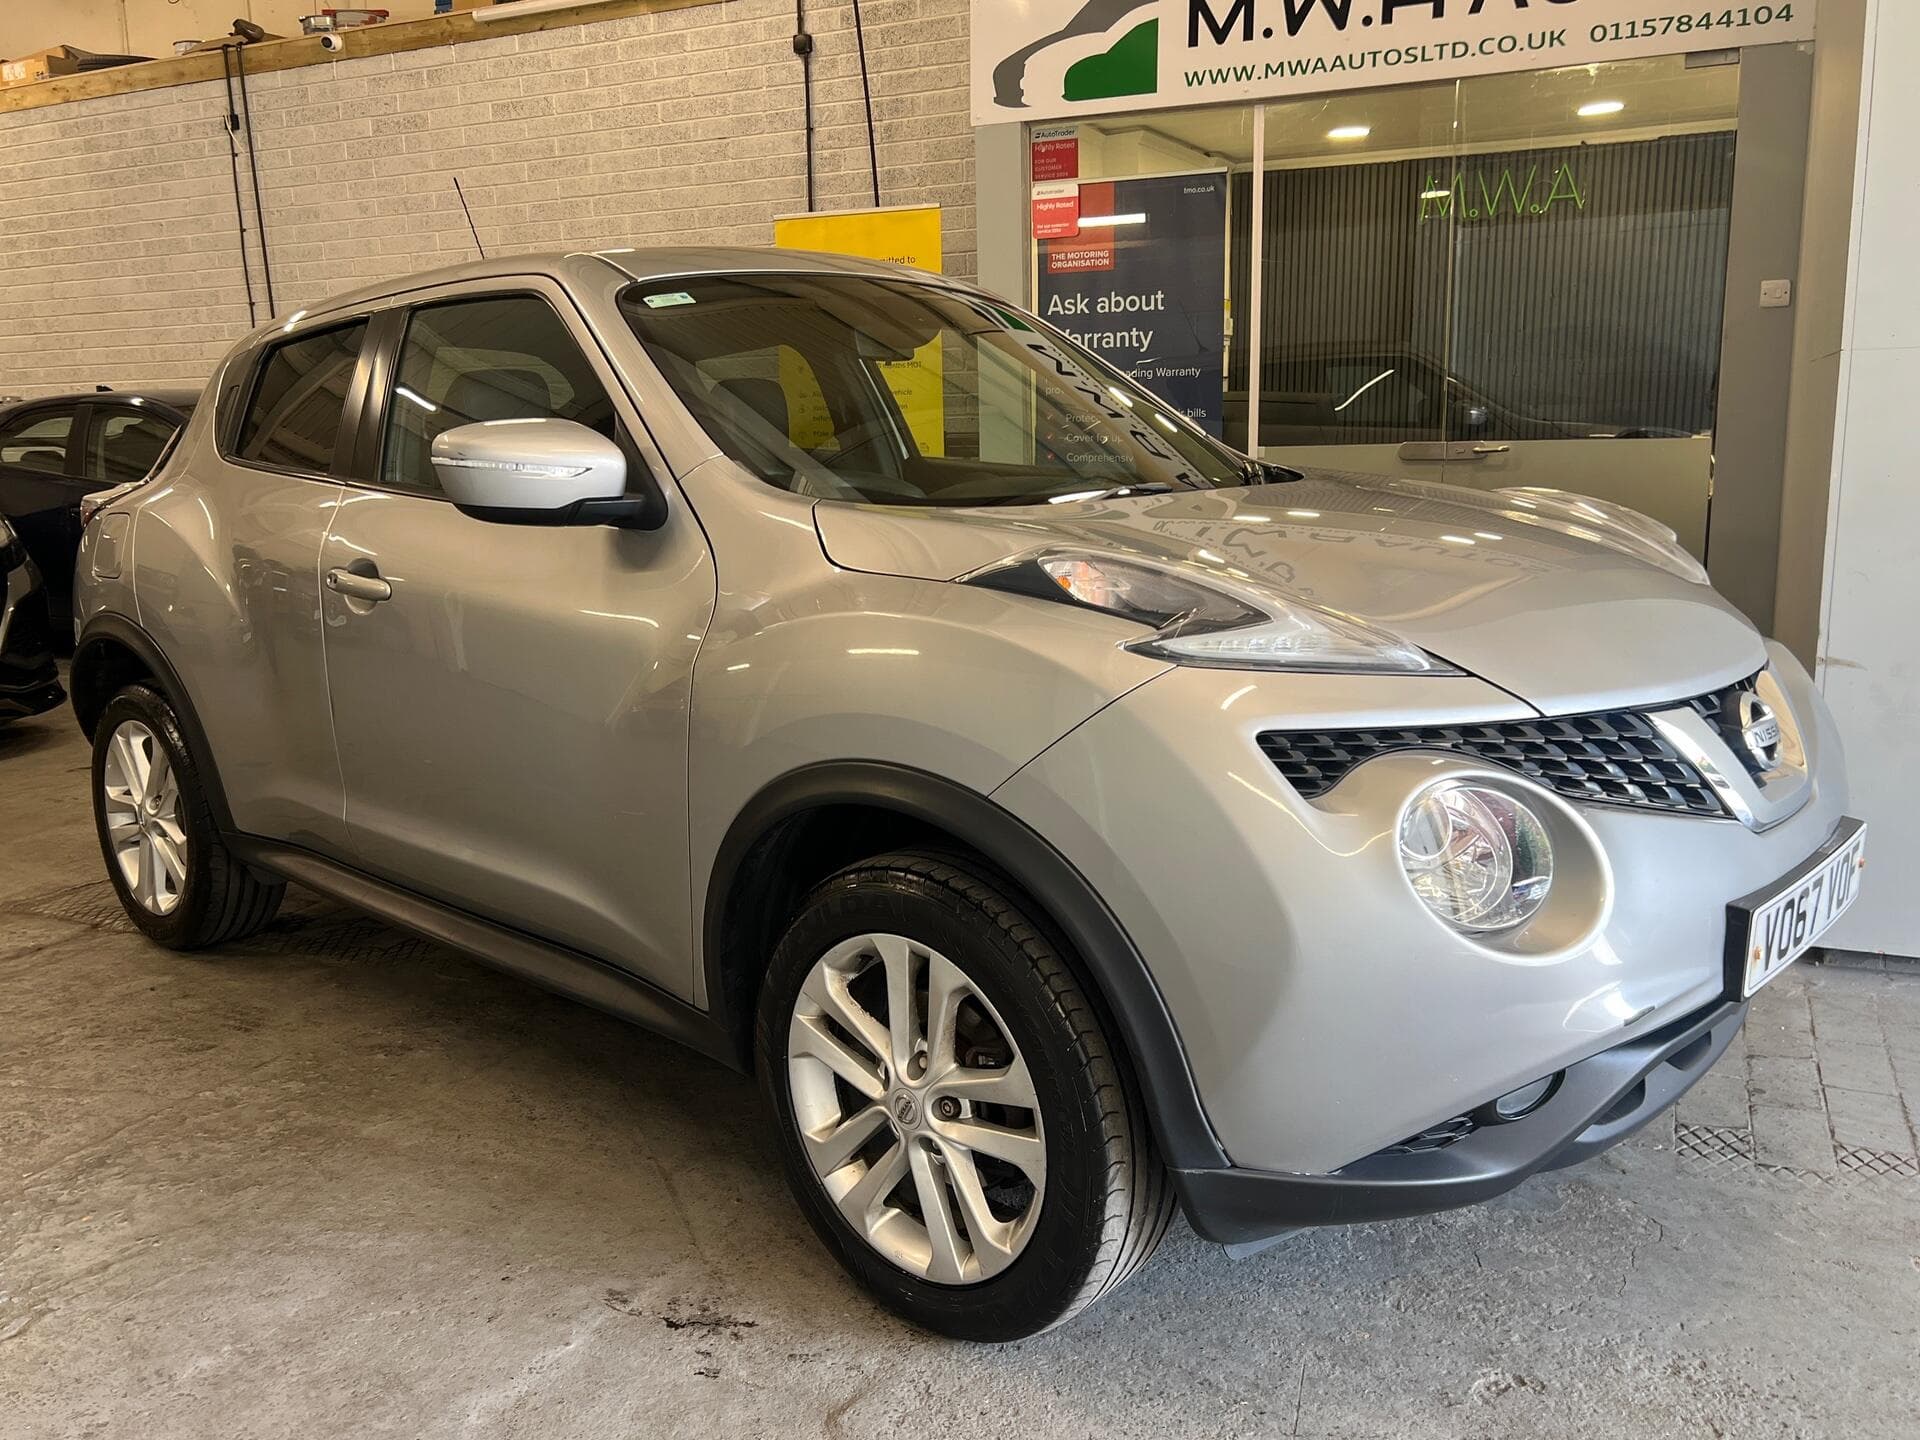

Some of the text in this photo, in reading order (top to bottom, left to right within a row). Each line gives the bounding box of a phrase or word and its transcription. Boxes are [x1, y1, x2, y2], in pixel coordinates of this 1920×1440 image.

[1184, 3, 1795, 88] WWW.MWAAUTOSLTD.CO.UK 01157844104
[1184, 185, 1215, 194] tmo.co.uk
[1421, 163, 1583, 222] M.W.A
[1052, 250, 1109, 261] THE MOTORING
[1052, 258, 1110, 269] ORGANISATION
[1047, 290, 1165, 315] Ask about
[1064, 327, 1153, 352] arranty
[1155, 367, 1201, 377] Warranty
[1065, 414, 1098, 423] Protec
[1187, 408, 1207, 418] bills
[1066, 433, 1095, 442] Cover
[1066, 452, 1134, 465] Comprehensiv
